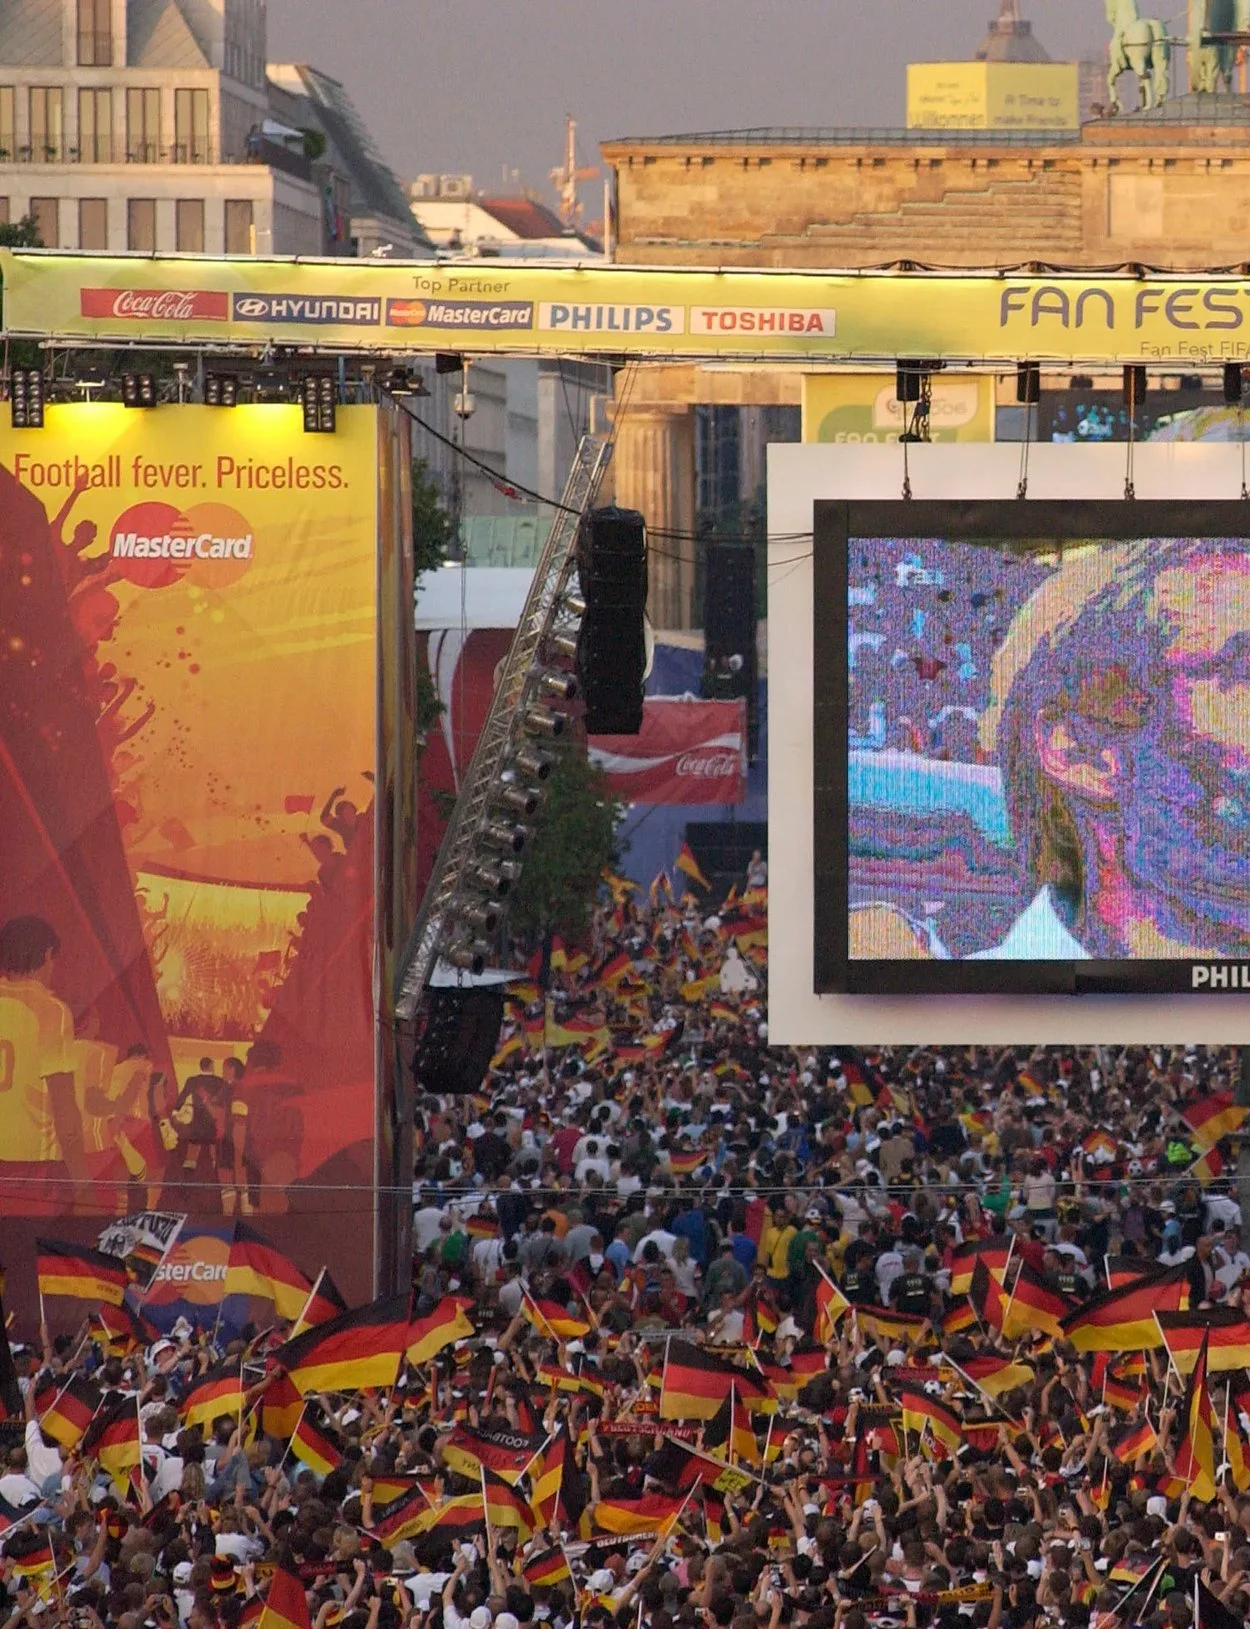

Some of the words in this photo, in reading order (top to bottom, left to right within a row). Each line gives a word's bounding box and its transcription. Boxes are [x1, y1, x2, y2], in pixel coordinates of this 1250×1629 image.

[413, 276, 442, 294] Top
[448, 278, 511, 294] Partner
[113, 290, 195, 319] Coca-Cola
[270, 300, 379, 321] HYUNDAI
[427, 305, 532, 325] MasterCard
[1000, 286, 1115, 330] FAN
[550, 304, 673, 333] PHILIPS
[701, 311, 825, 333] TOSHIBA
[1140, 341, 1171, 357] Fan
[1178, 341, 1214, 357] Fest
[14, 453, 121, 489] Football
[132, 456, 206, 490] fever.
[216, 455, 349, 490] Priceless.
[113, 532, 252, 559] MasterCard
[676, 752, 738, 777] Coca-Cola
[155, 1261, 228, 1281] sterCar
